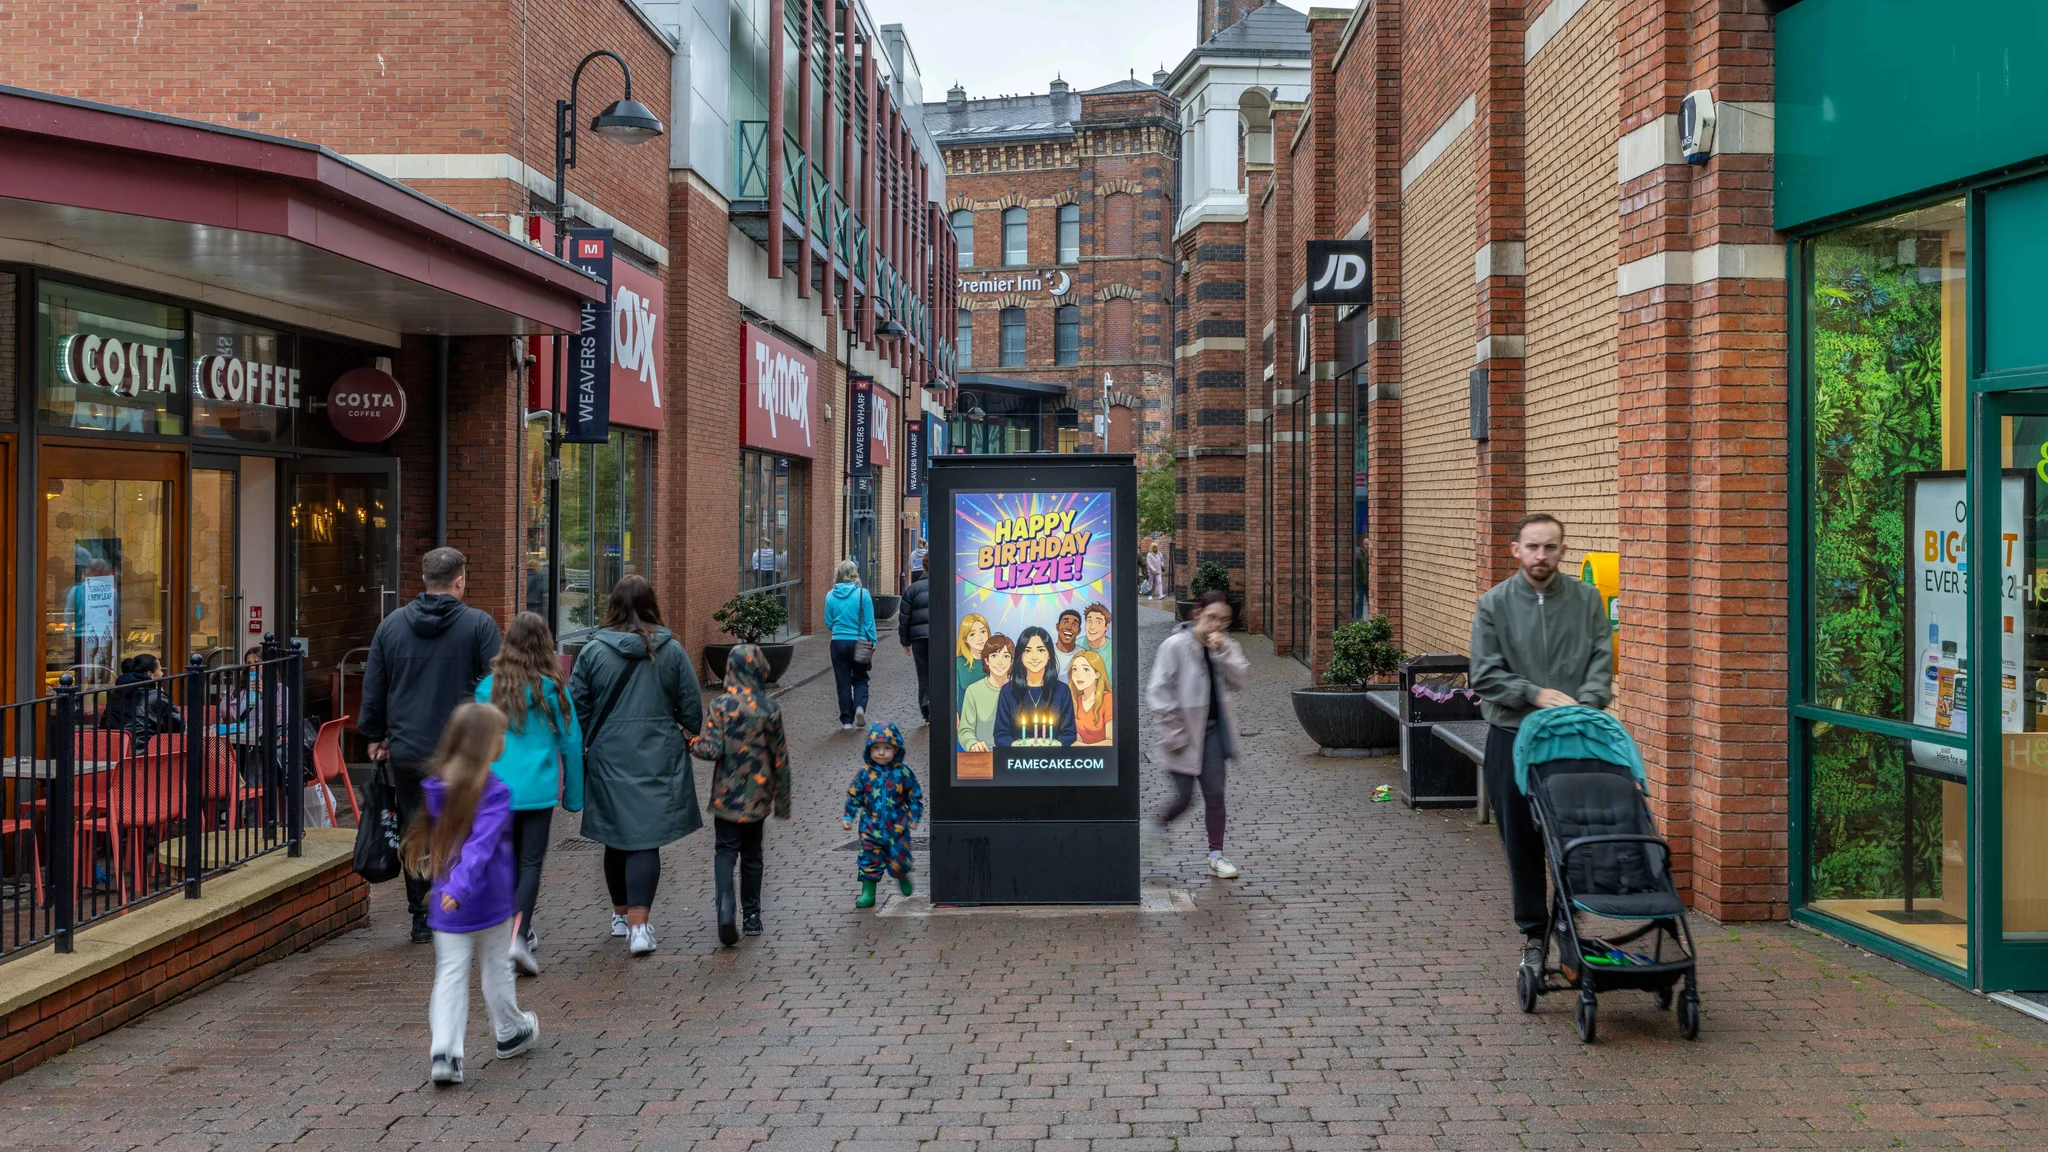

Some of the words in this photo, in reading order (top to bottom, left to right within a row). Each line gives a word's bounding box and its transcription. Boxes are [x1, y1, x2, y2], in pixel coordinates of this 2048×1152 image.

[584, 244, 598, 254] M
[1017, 276, 1041, 291] Inn
[1313, 254, 1366, 291] JD
[581, 265, 597, 332] WHF
[610, 285, 661, 408] axx
[82, 334, 177, 397] COSTA
[211, 355, 300, 408] COFFEE
[578, 336, 597, 423] WEAVERS
[335, 393, 394, 408] COSTA
[348, 410, 381, 418] COFFEE
[857, 392, 866, 425] WHARF
[855, 426, 865, 468] WEAVERS
[995, 509, 1077, 544] HAPPY
[978, 531, 1092, 570] BIRTHDAY
[1924, 530, 2018, 567] BIGT
[994, 554, 1084, 590] LIZZIE!
[1925, 570, 1960, 594] EVER
[90, 593, 101, 601] NEW
[101, 592, 113, 600] LEAF
[1007, 758, 1104, 769] FAMECAKE.COM
[1936, 751, 1951, 762] Here
